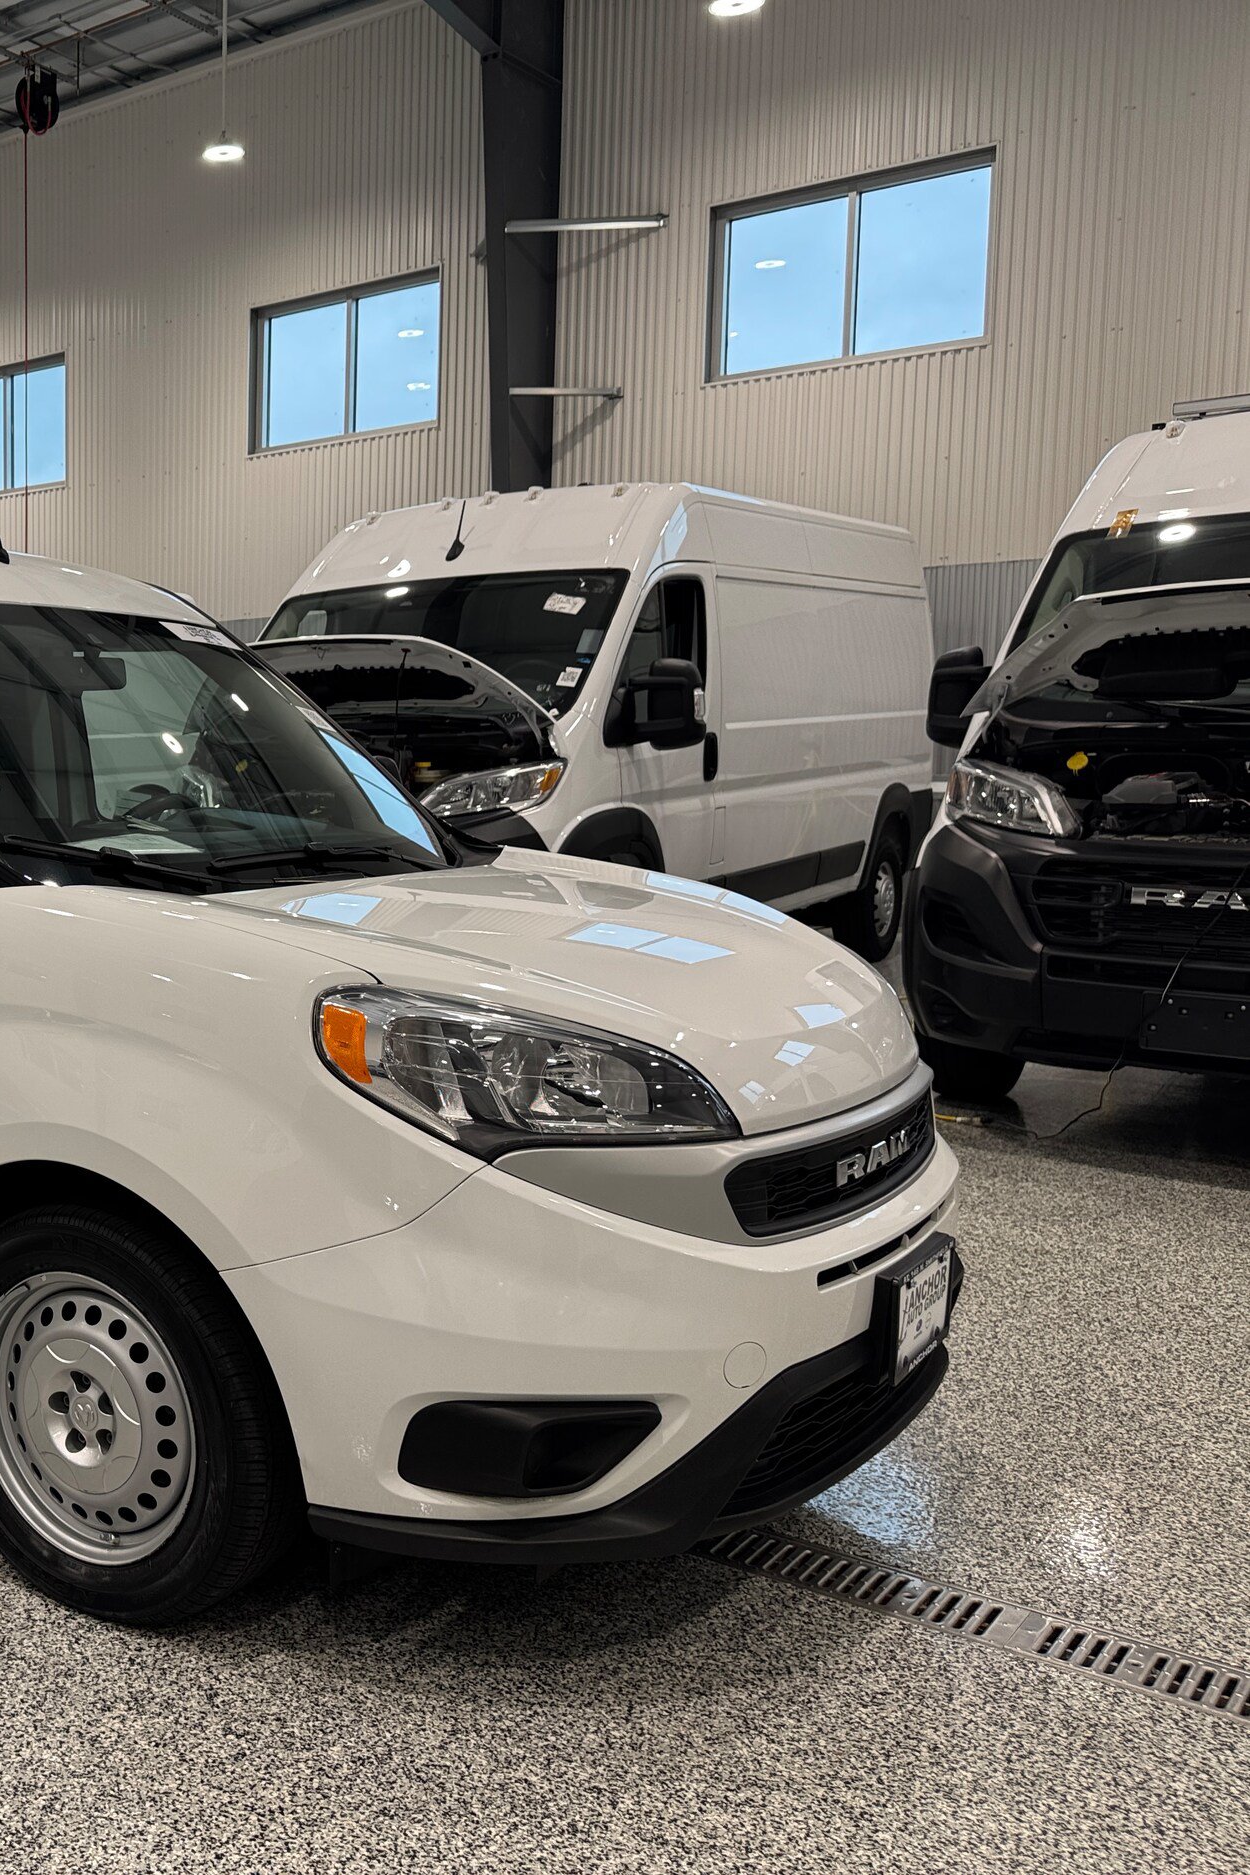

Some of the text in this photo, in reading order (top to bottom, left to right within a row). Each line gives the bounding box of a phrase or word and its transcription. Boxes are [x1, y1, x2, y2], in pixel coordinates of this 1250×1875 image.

[1130, 886, 1250, 912] RA
[836, 1129, 910, 1188] RAM
[907, 1284, 946, 1325] AUTO GROUP
[909, 1265, 947, 1309] ANCHOR
[909, 1340, 938, 1372] ANCHOR
